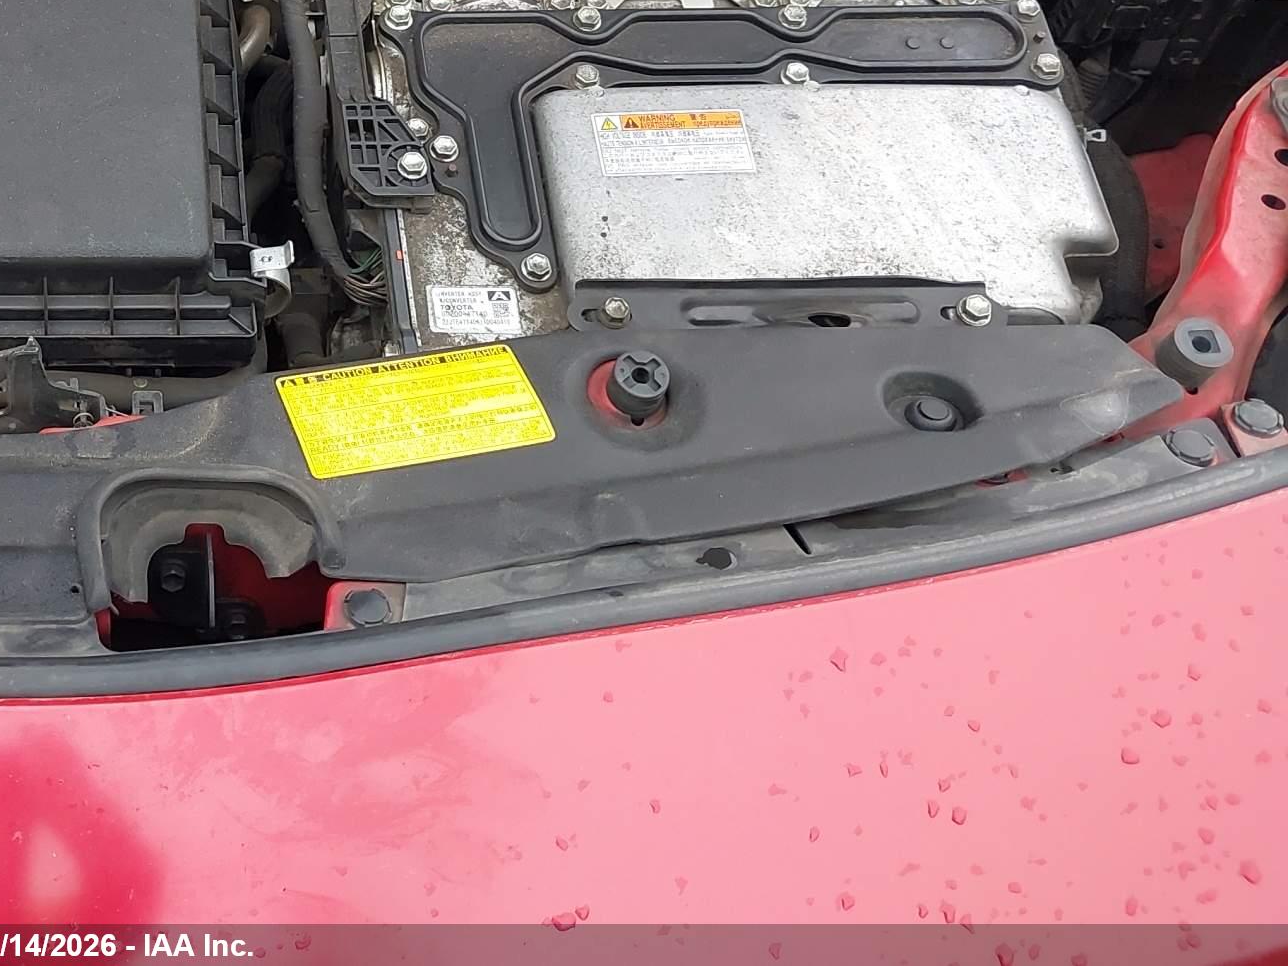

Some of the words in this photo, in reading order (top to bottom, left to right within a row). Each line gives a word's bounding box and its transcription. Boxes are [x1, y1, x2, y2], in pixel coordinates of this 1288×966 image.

[638, 113, 676, 123] WARNING
[322, 365, 372, 381] CAUTION
[377, 357, 441, 373] ATTENTION
